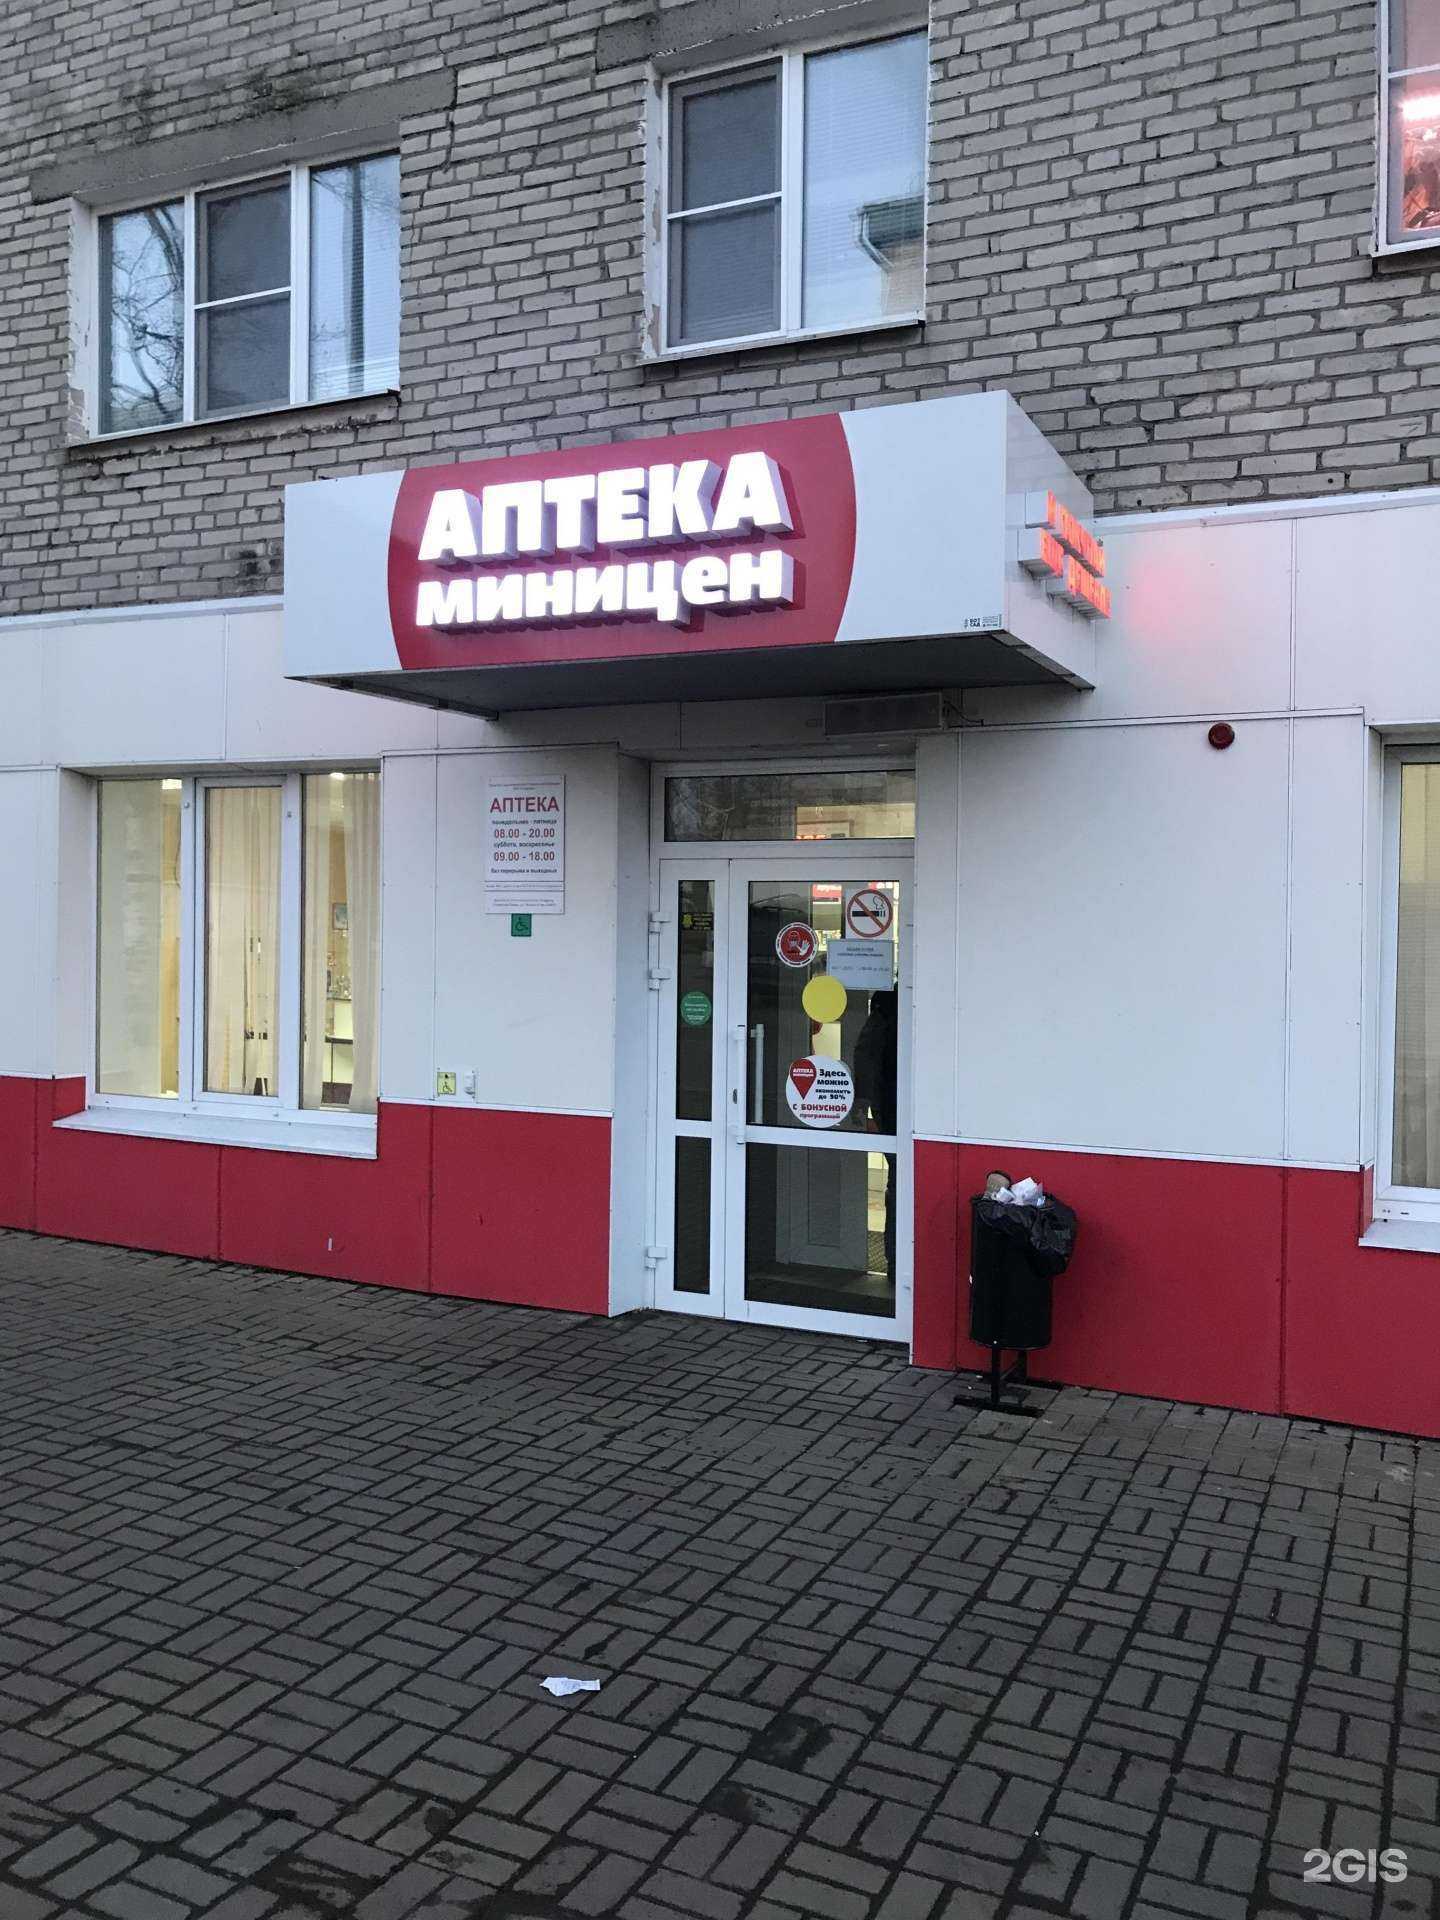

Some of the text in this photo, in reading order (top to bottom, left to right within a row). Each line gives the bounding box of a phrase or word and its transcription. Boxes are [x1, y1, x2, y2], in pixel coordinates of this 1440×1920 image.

[418, 450, 794, 562] АПТЕКА
[416, 549, 793, 627] миницен
[490, 796, 560, 813] АПТЕКА
[494, 829, 520, 839] 08.00
[529, 828, 555, 838] 20.00
[494, 851, 520, 861] 09.00
[529, 851, 555, 861] 18.00
[819, 1069, 847, 1077] Здесь
[801, 1103, 848, 1112] БОНУСНОЙ
